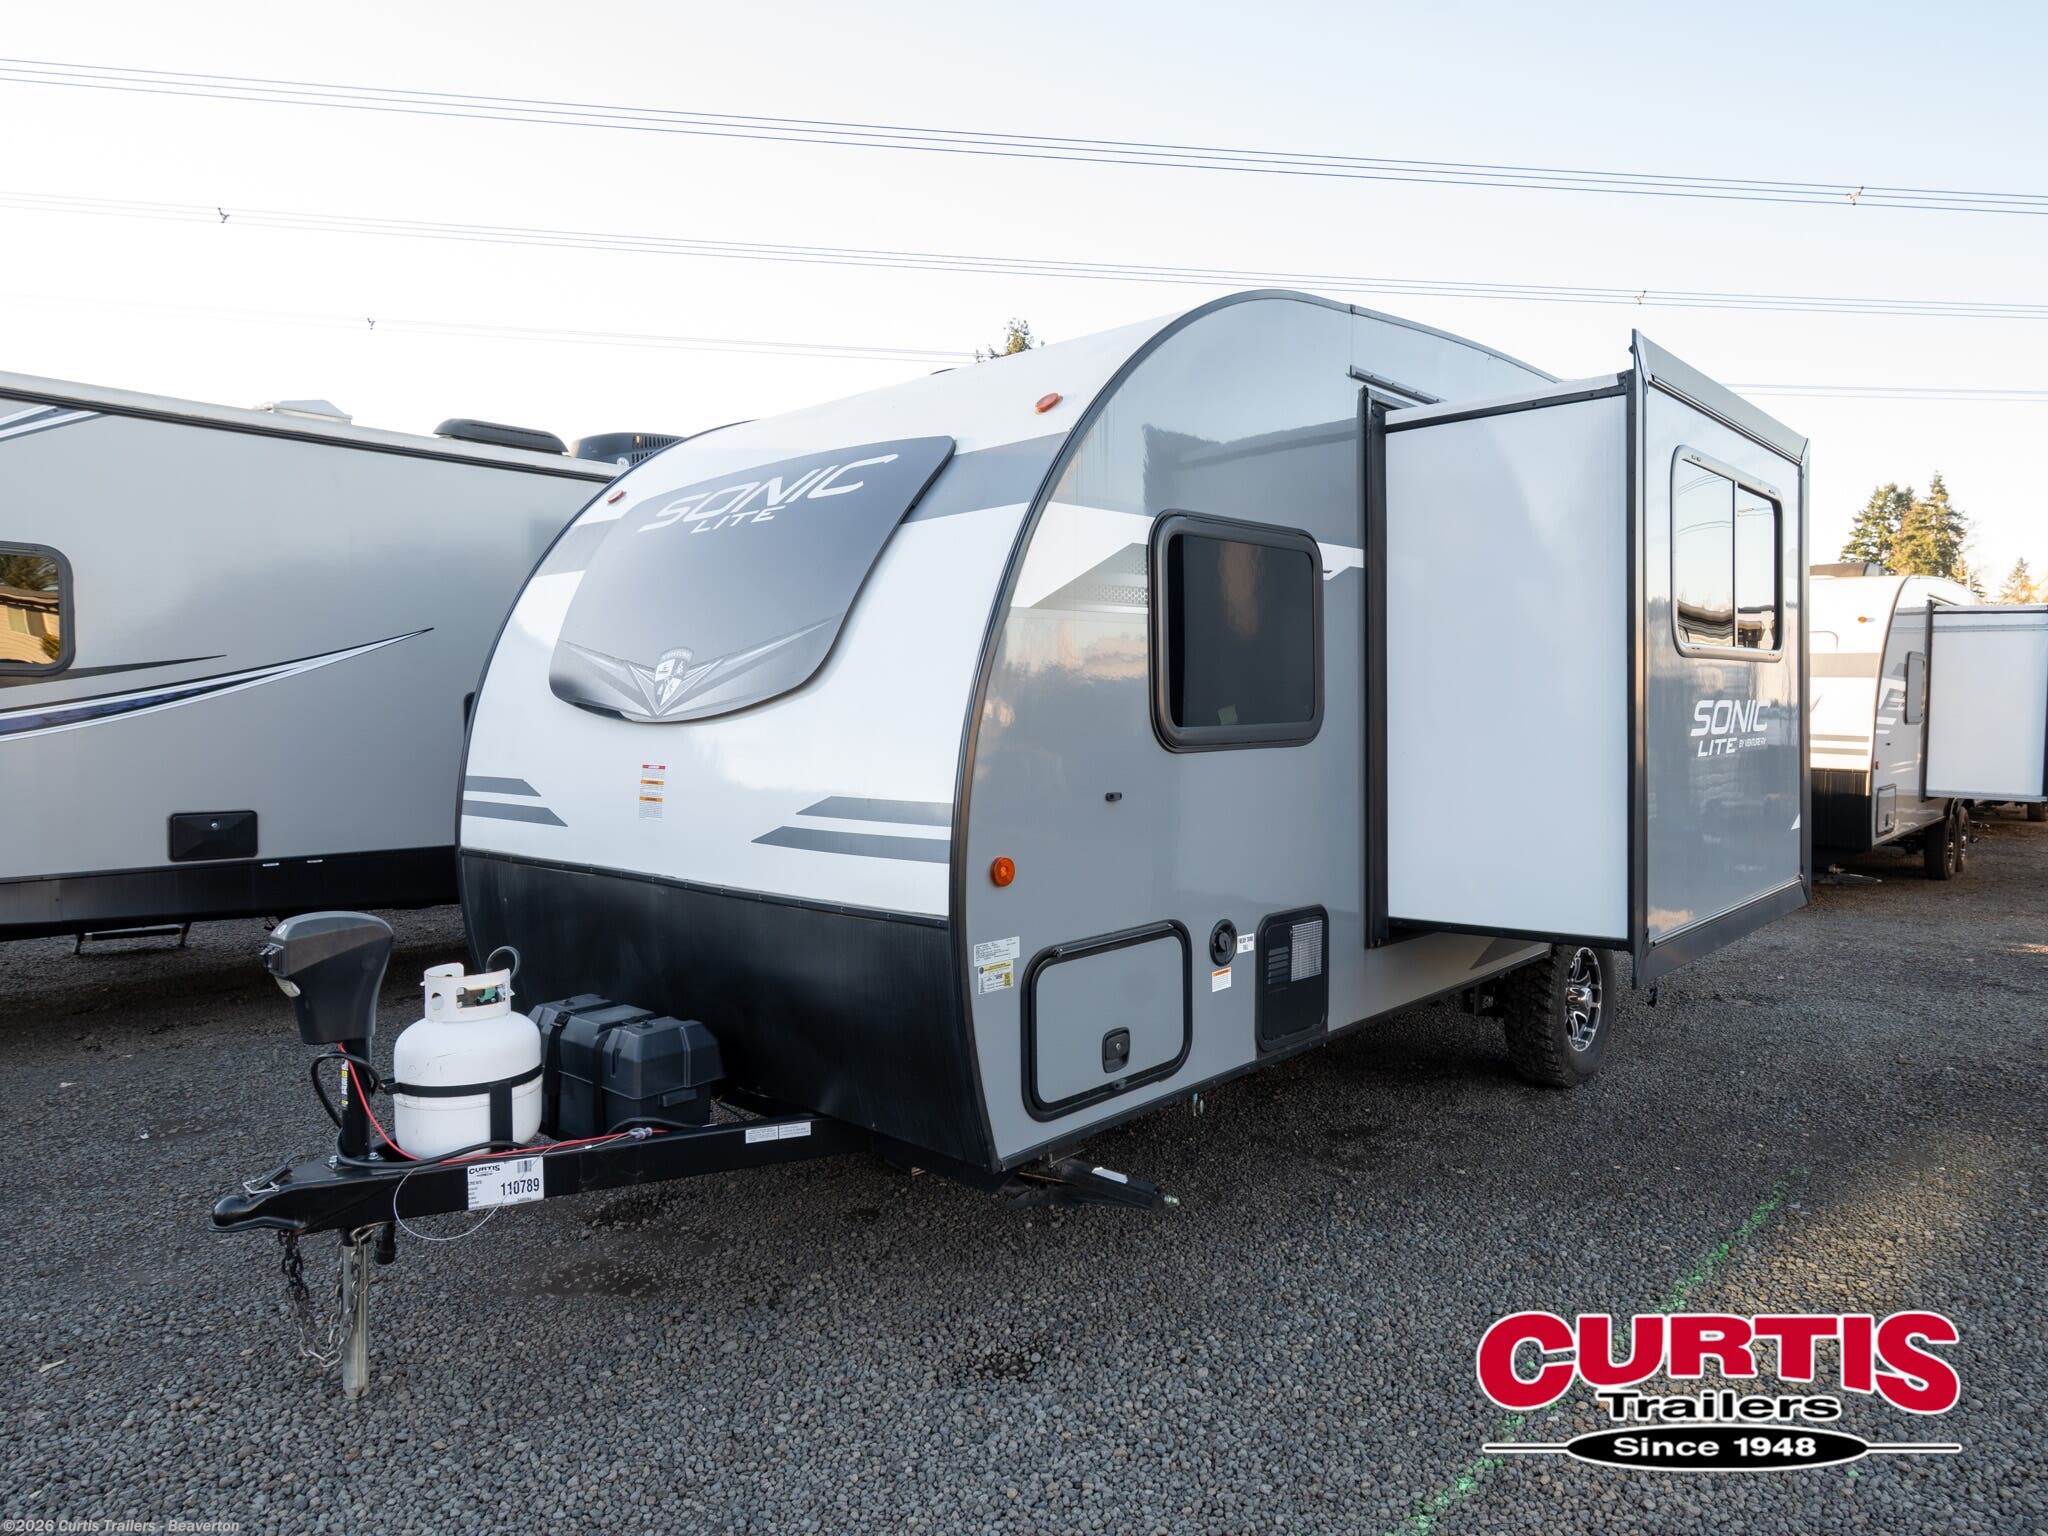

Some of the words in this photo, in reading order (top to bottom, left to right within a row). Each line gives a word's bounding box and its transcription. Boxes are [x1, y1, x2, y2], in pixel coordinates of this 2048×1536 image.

[637, 453, 899, 533] SONIC
[690, 504, 786, 534] LITE
[1690, 699, 1772, 737] SONIC
[1697, 737, 1738, 757] LITE
[469, 1164, 501, 1175] CURTIS
[501, 1177, 540, 1196] 110789
